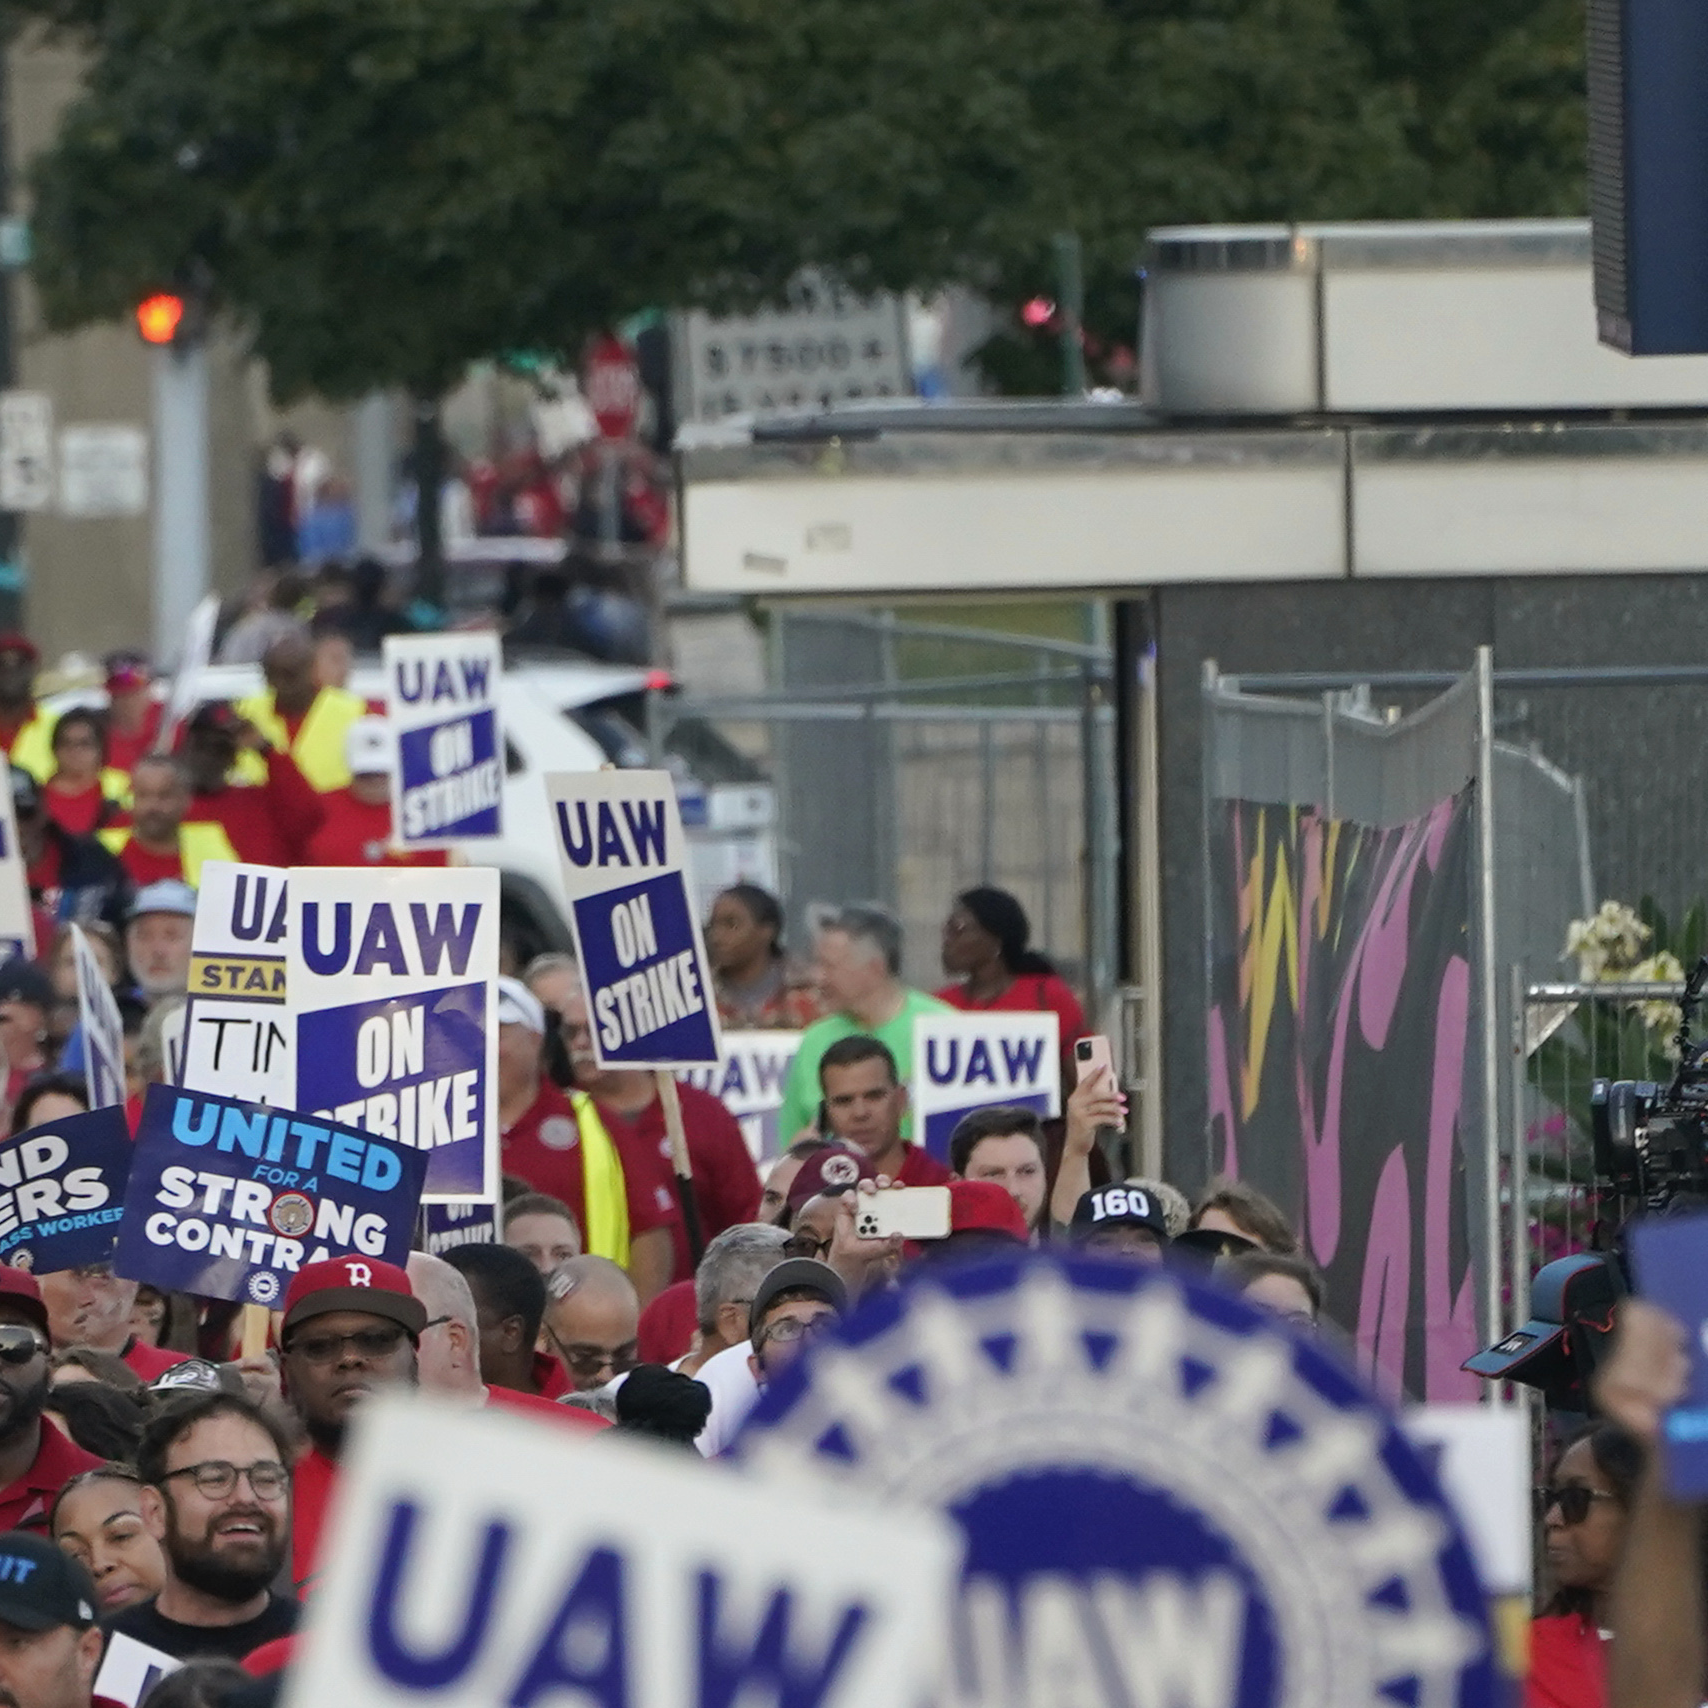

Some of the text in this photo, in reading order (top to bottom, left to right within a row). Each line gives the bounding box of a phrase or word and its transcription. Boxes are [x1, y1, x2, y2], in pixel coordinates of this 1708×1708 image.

[397, 656, 491, 706] UAW
[428, 720, 474, 777] ON
[401, 757, 500, 838] STRIKE
[556, 799, 669, 869] UAW
[300, 902, 484, 978] UAW
[610, 892, 659, 970] ON
[595, 950, 704, 1053] STRIKE
[356, 1004, 426, 1090] ON
[926, 1036, 1046, 1087] UAW
[170, 1096, 403, 1193] UNITED
[251, 1164, 319, 1194] FOR A
[154, 1164, 388, 1258] STRNG
[1090, 1187, 1150, 1220] 160
